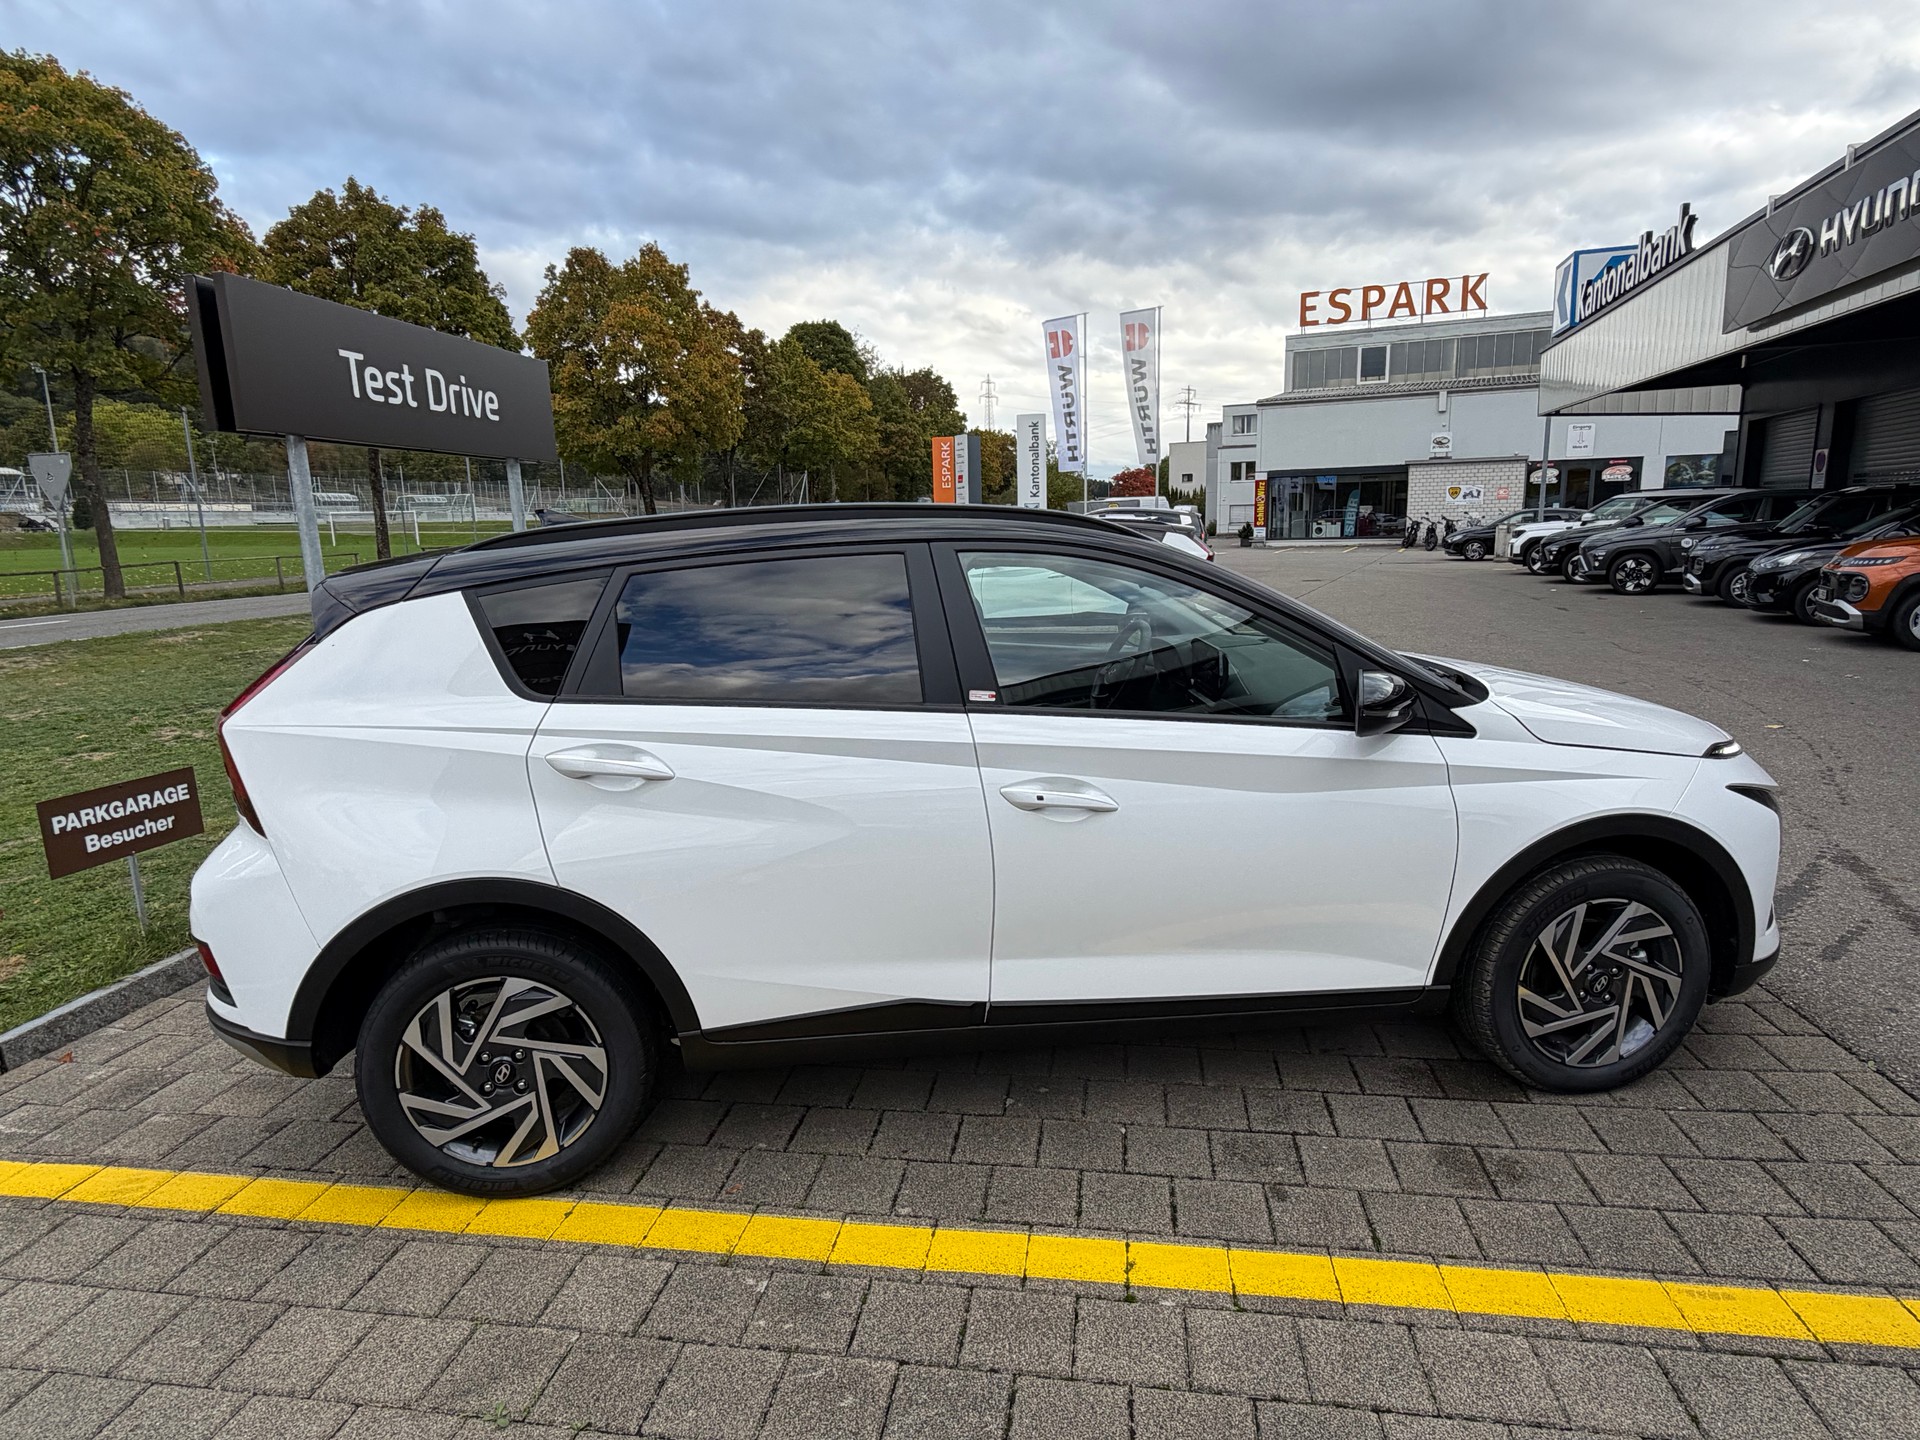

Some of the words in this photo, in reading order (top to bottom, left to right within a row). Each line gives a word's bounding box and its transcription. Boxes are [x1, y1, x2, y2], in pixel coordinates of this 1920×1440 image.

[1575, 202, 1698, 323] Kantonalbank
[1300, 272, 1490, 327] ESPARK
[338, 348, 418, 408] Test
[425, 367, 500, 422] Drive
[941, 442, 952, 489] ESPARK
[1029, 420, 1040, 498] Kantonalbank
[51, 783, 191, 835] PARKGARAGE
[84, 814, 176, 853] Besucher
